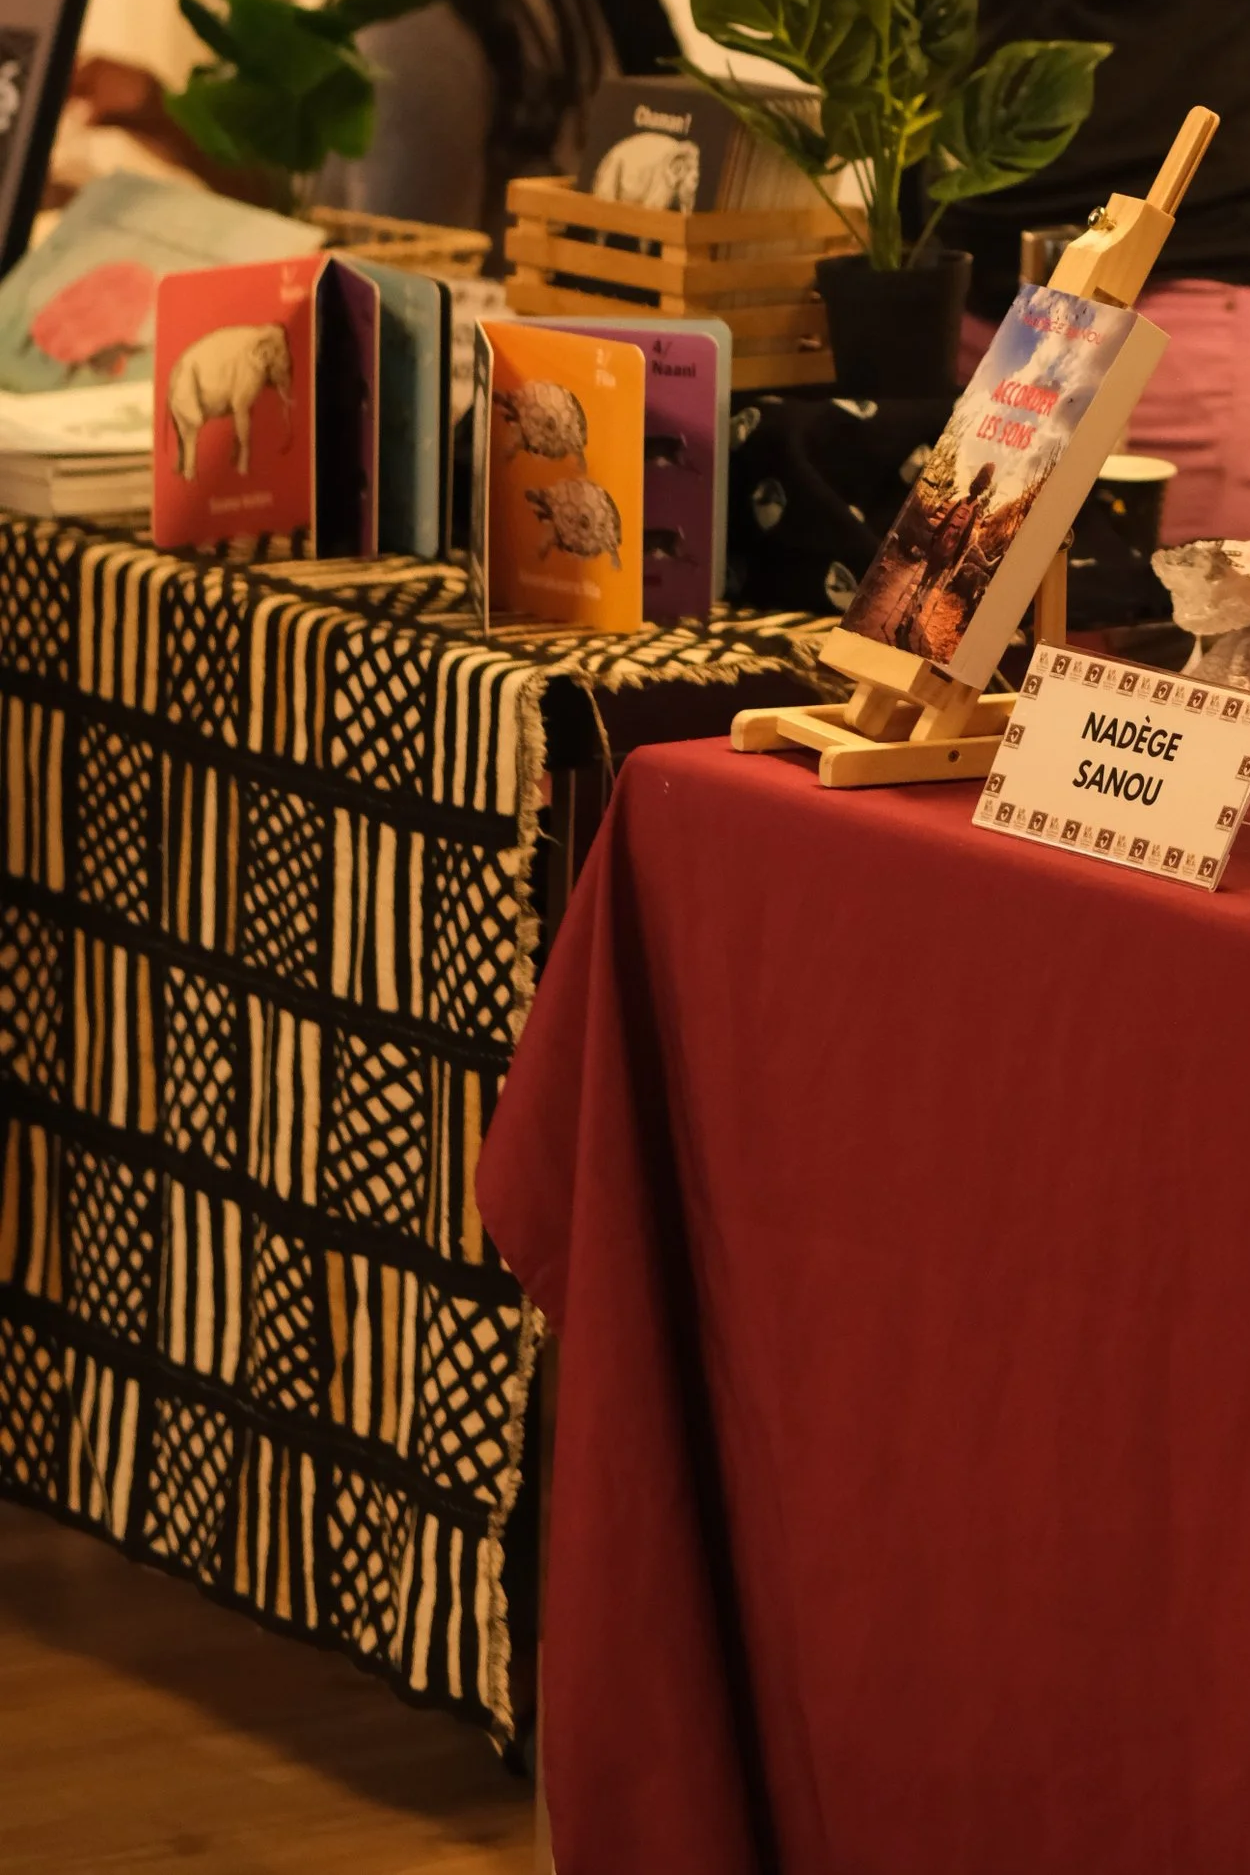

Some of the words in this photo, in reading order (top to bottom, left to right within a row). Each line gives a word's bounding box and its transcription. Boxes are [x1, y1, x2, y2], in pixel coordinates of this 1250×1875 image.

[991, 378, 1059, 417] ACCORDER
[976, 413, 1002, 441] LES
[997, 418, 1036, 451] SONS
[1081, 710, 1183, 762] NADÈGE
[1072, 758, 1164, 807] SANOU
